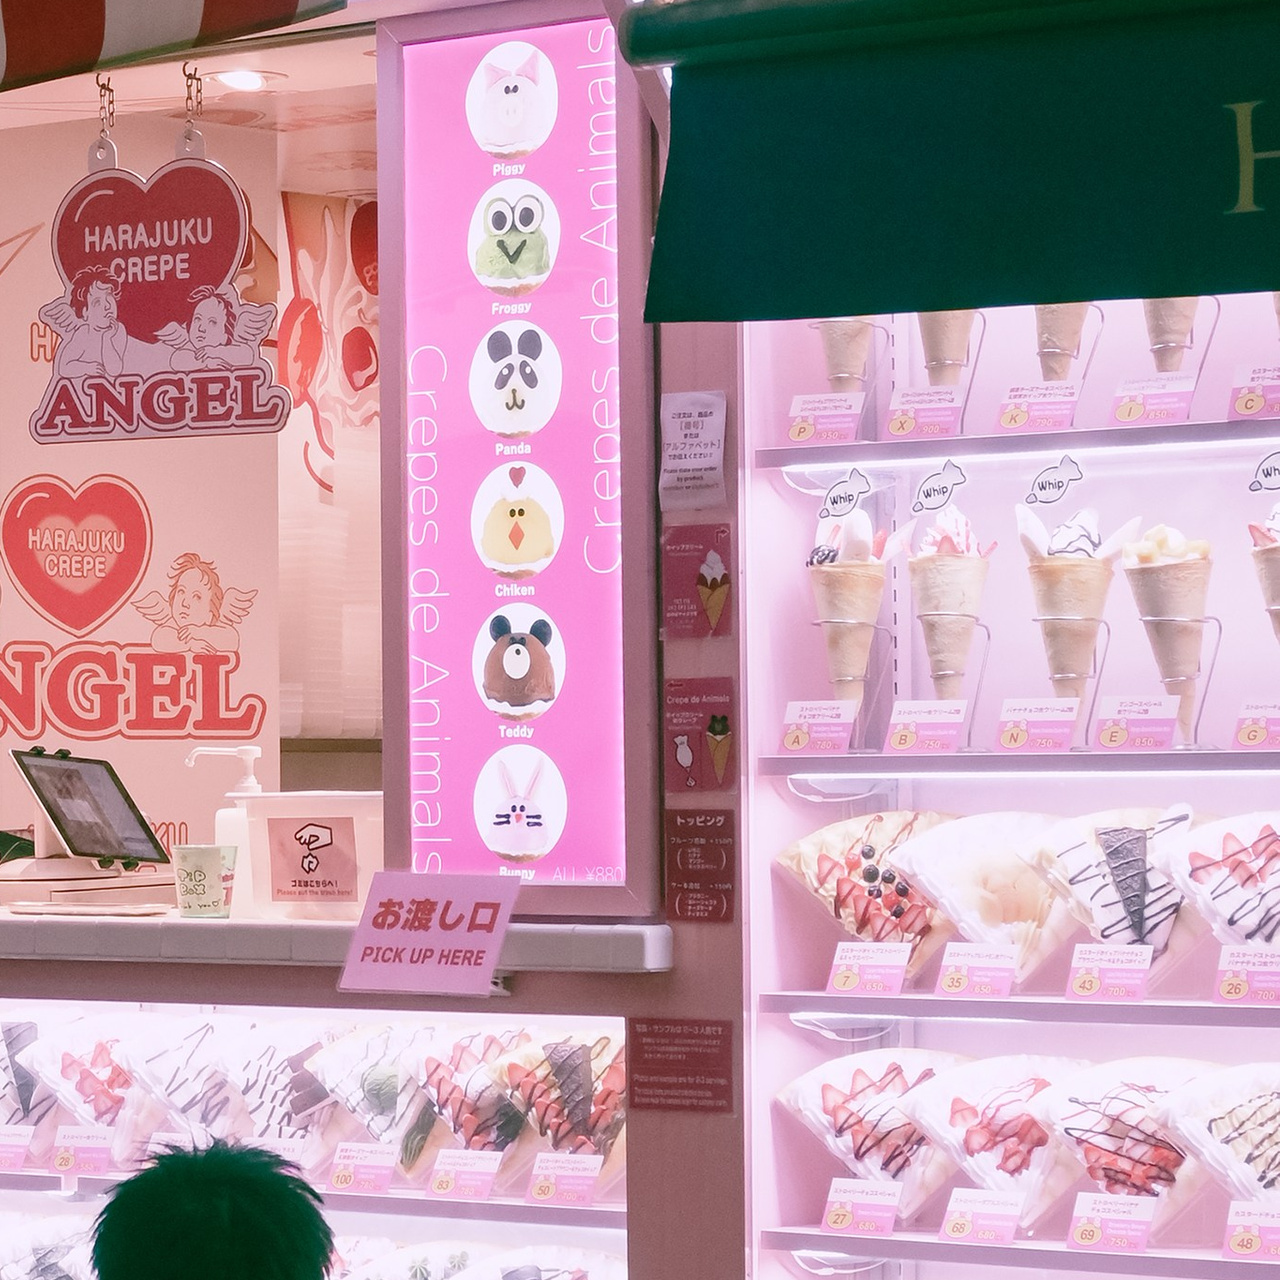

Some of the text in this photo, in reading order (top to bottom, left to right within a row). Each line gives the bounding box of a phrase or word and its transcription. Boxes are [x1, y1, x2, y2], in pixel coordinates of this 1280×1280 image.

[492, 161, 526, 178] Piggy
[84, 217, 213, 254] HARAJUKU
[110, 254, 191, 284] CREPE
[577, 24, 624, 575] Crepes de Animals
[491, 300, 532, 318] Froggy
[36, 366, 287, 435] ANGEL
[1244, 398, 1254, 409] C
[797, 426, 806, 437] P
[897, 420, 907, 431] X
[495, 442, 531, 457] Panda
[922, 483, 949, 502] Whip
[1037, 478, 1065, 495] Whip
[829, 490, 855, 509] Whip
[27, 528, 125, 554] HARAJUKU
[44, 555, 107, 579] CREPE
[494, 583, 535, 598] Chiken
[407, 345, 452, 874] Crepes de Animals
[666, 695, 689, 704] Crepe
[701, 694, 730, 703] Animals
[498, 724, 534, 740] Teddy
[1008, 732, 1019, 744] N
[1109, 731, 1119, 743] E
[1247, 729, 1258, 741] G
[791, 734, 801, 746] A
[898, 734, 908, 746] B
[677, 815, 725, 826] トッピング
[499, 866, 536, 880] Bunny
[586, 866, 624, 882] ¥880
[291, 879, 338, 888] ゴミはこちらへ！
[276, 888, 296, 896] Please
[371, 898, 501, 934] お渡し口
[361, 946, 486, 967] PICK UP HERE
[842, 975, 850, 986] 7
[948, 977, 962, 988] 35
[1079, 979, 1093, 991] 43
[1226, 983, 1241, 995] 26
[58, 1156, 70, 1167] 28
[334, 1173, 352, 1185] 100
[436, 1179, 451, 1191] 83
[537, 1185, 551, 1196] 50
[833, 1214, 847, 1225] 27
[951, 1222, 966, 1233] 68
[1080, 1229, 1095, 1241] 69
[1237, 1237, 1253, 1250] 48
